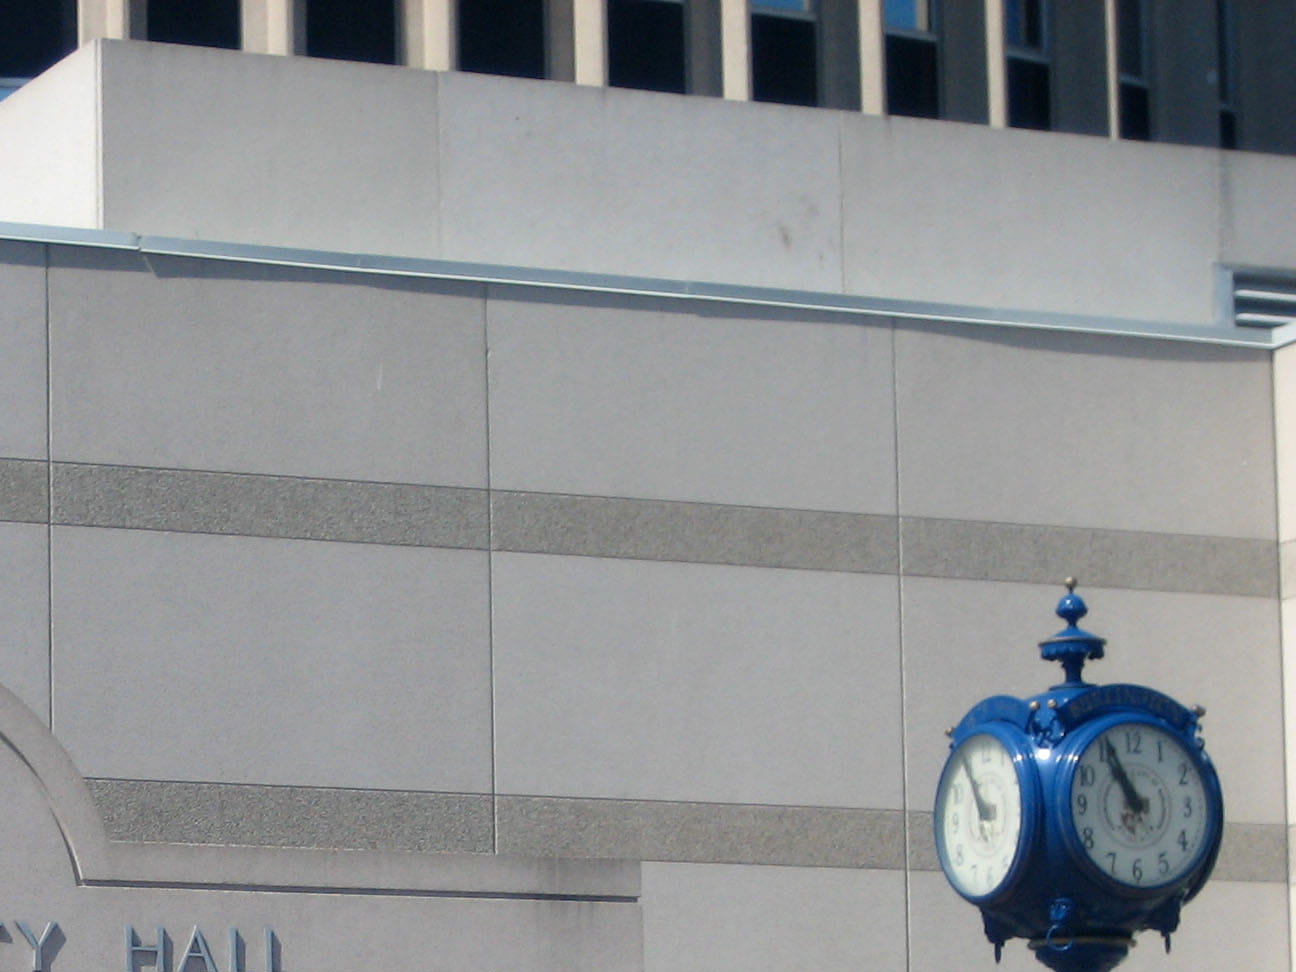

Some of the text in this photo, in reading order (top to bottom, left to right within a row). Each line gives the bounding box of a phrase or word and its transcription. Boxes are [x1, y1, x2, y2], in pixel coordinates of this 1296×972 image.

[1125, 732, 1143, 754] 12
[1079, 765, 1095, 787] 10
[1178, 763, 1190, 785] 2
[1077, 793, 1087, 816] 9
[1183, 797, 1193, 818] 3
[1082, 827, 1095, 849] 8
[1178, 830, 1189, 852] 4
[1106, 853, 1117, 876] 7
[1132, 858, 1143, 883] 6
[1158, 851, 1170, 874] 5
